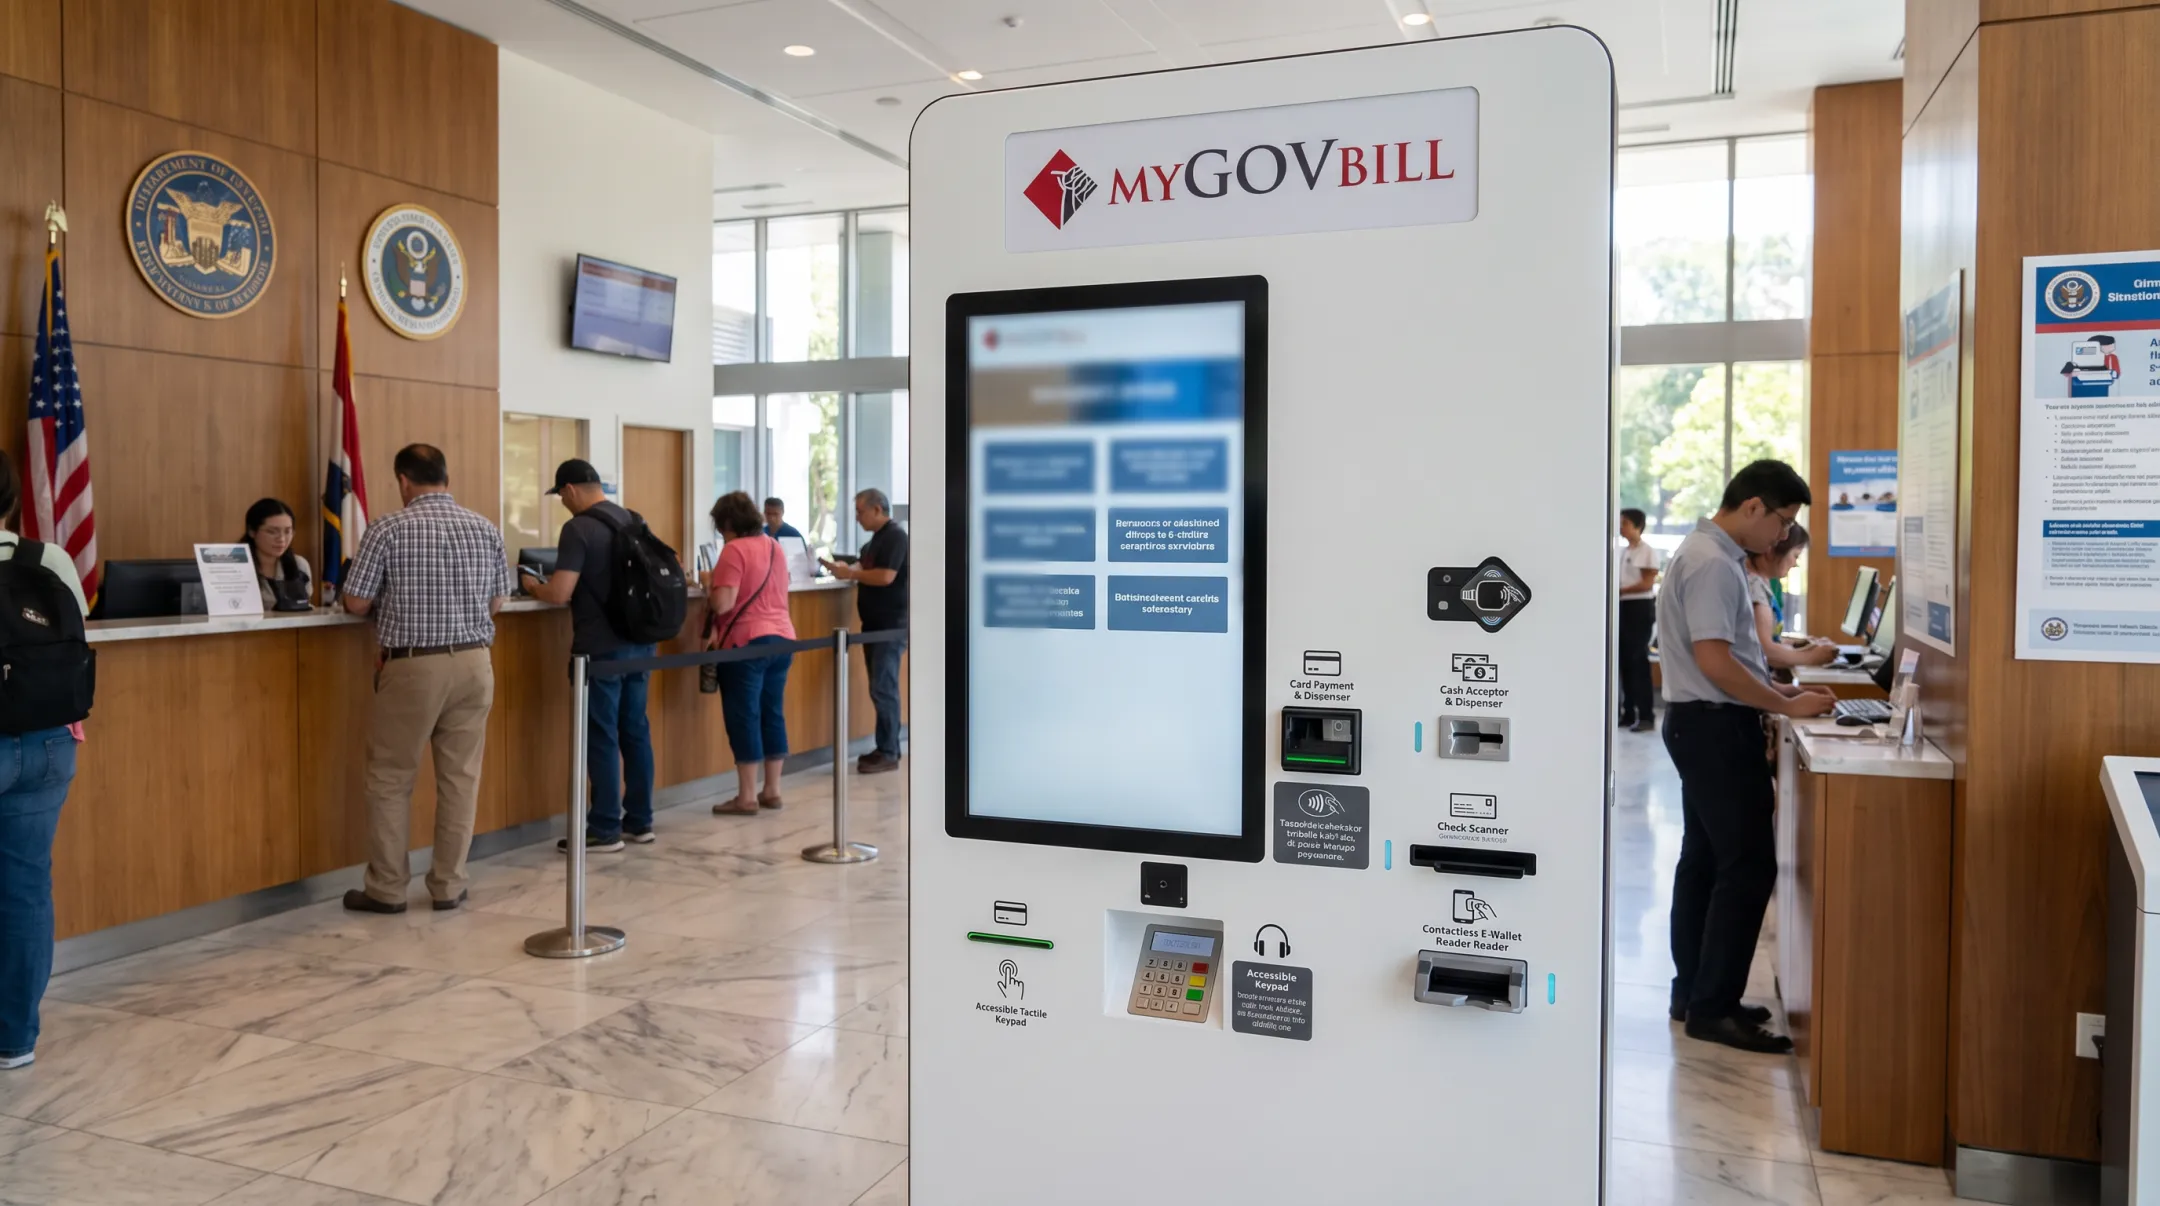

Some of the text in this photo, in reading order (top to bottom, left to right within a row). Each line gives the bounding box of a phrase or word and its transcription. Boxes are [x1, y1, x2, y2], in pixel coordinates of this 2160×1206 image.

[1290, 679, 1355, 692] Card Payment
[1440, 685, 1510, 698] Cash Acceptor
[1294, 690, 1302, 700] &
[1444, 697, 1503, 709] & Dispenser
[1437, 821, 1509, 836] Check Scanner
[1481, 929, 1522, 942] E-Wallet
[1436, 936, 1509, 952] Reader Reader
[1246, 968, 1298, 983] Accessible
[1255, 980, 1289, 992] Keypad
[975, 1002, 1048, 1019] Accessible Tactile
[995, 1015, 1027, 1027] Keypad
